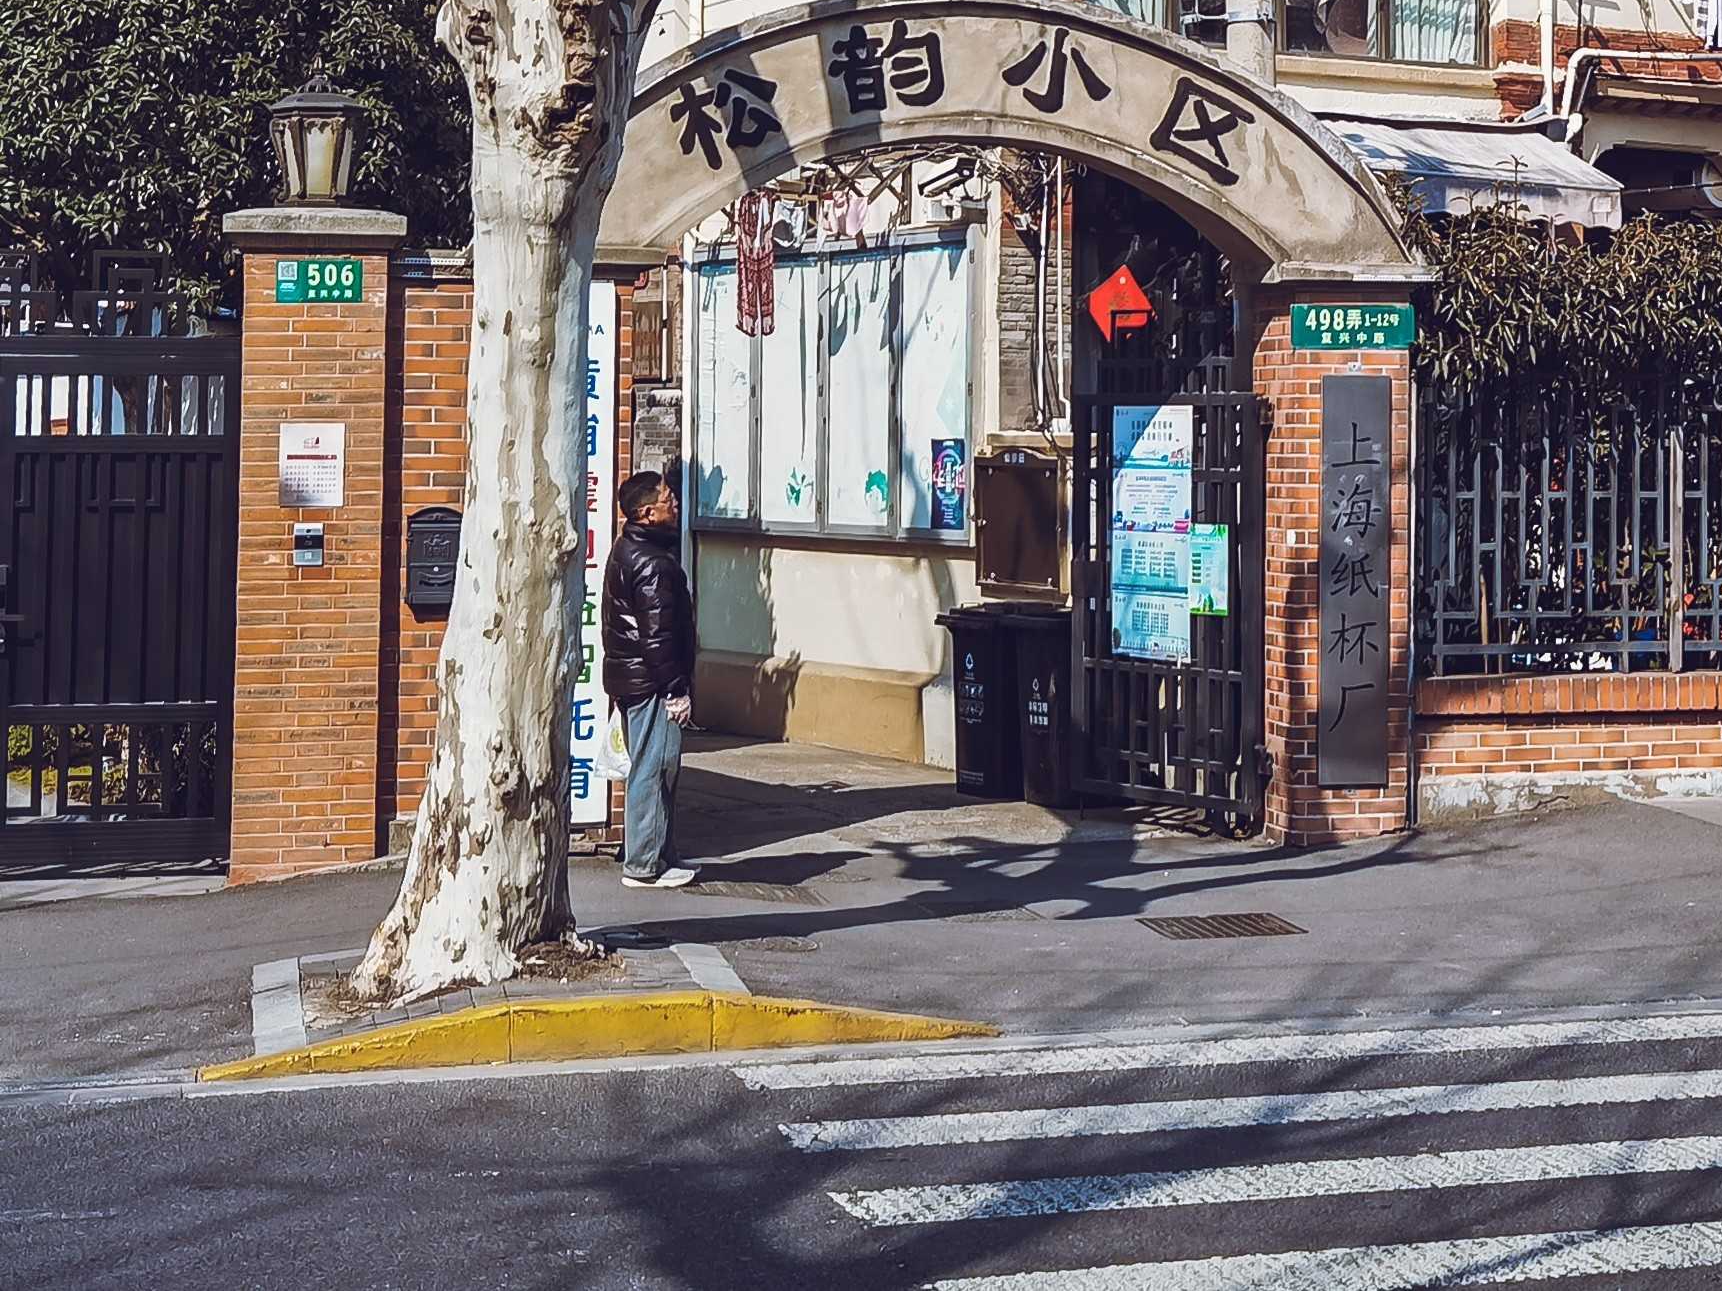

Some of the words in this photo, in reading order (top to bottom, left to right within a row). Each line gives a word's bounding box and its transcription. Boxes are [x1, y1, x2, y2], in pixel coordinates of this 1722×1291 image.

[670, 19, 1255, 186] 松韵小区
[307, 264, 354, 286] 506
[1305, 309, 1400, 331] 498弄1-12号
[1321, 332, 1385, 344] 复兴中路
[1328, 421, 1381, 733] 上海纸杯厂
